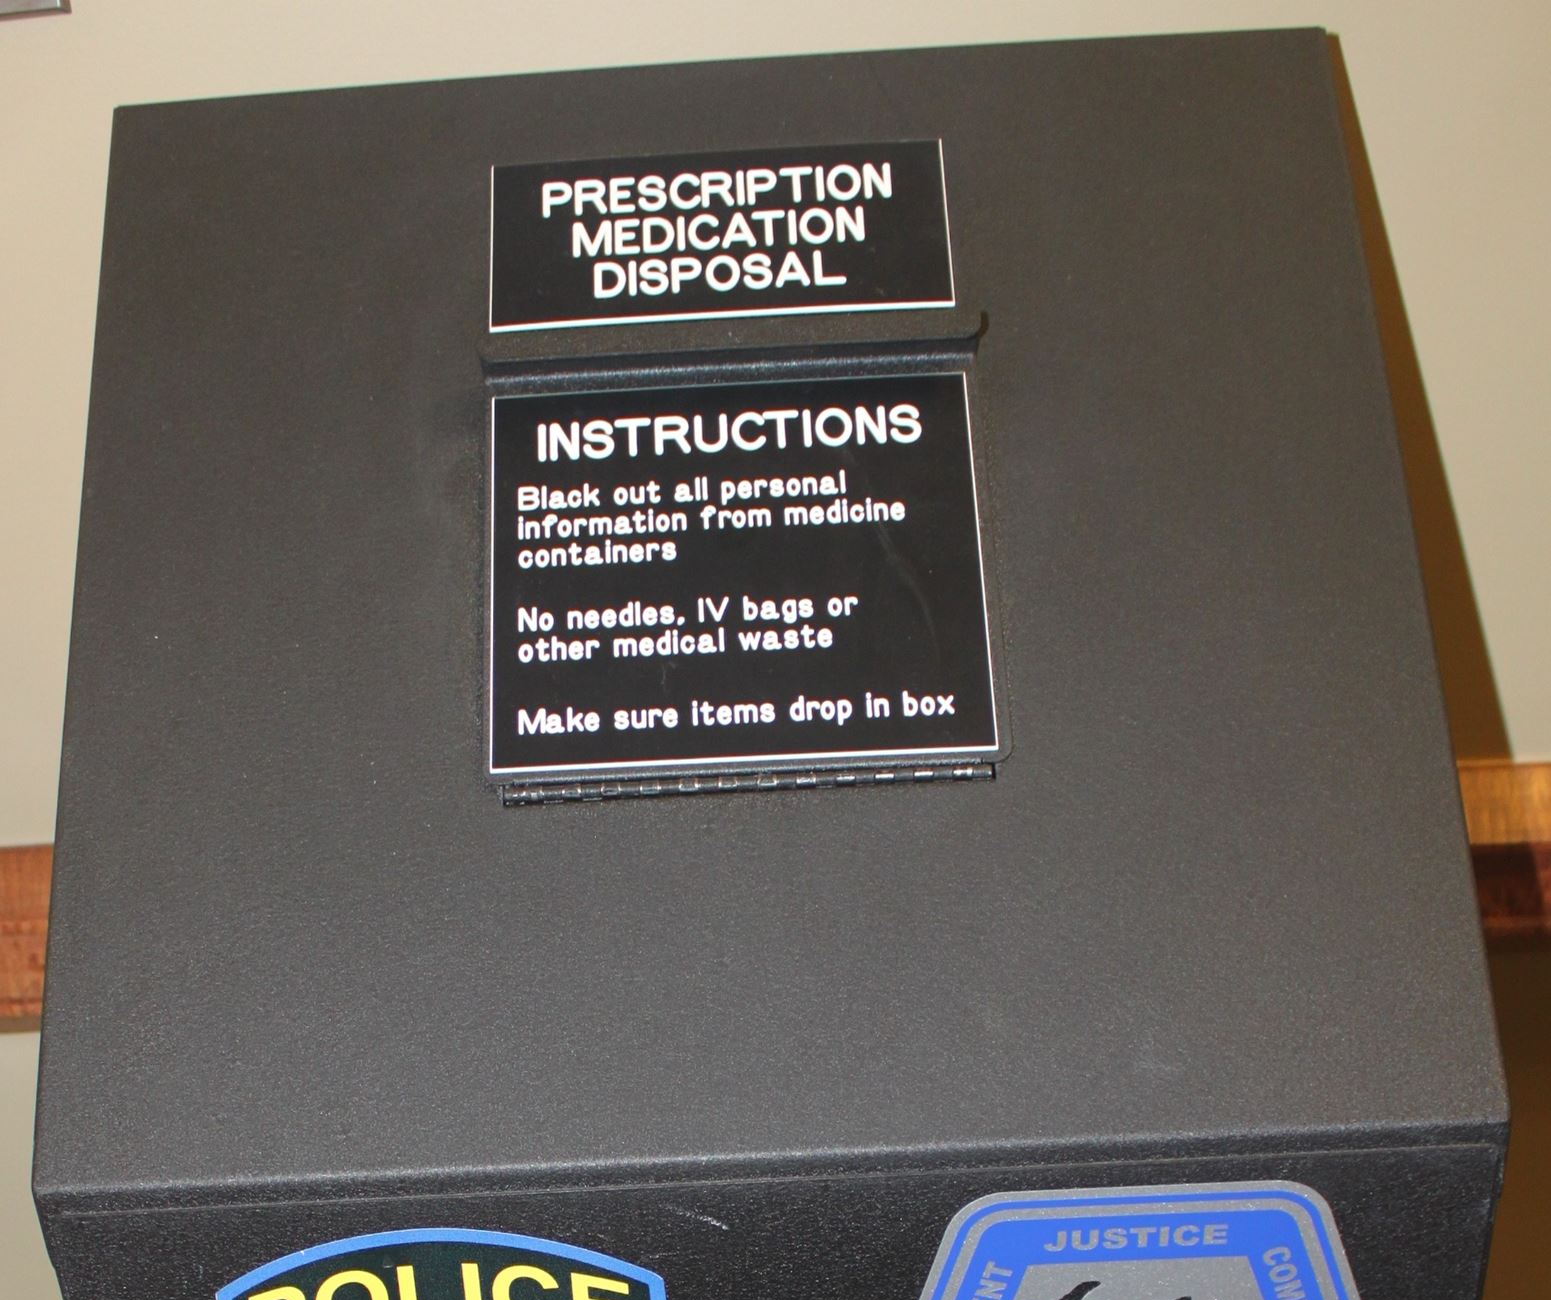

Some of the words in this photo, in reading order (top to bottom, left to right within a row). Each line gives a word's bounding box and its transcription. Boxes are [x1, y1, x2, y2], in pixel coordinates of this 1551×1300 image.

[542, 162, 892, 218] PRESCRIPTION
[571, 205, 865, 258] MEDICATION
[592, 250, 847, 298] DISPOSAL
[537, 404, 922, 462] INSTRUCTIONS
[517, 483, 601, 511] Black
[613, 481, 661, 506] out
[674, 477, 709, 502] all
[721, 470, 846, 504] personal
[517, 508, 687, 540] information
[700, 503, 772, 530] from
[783, 497, 906, 525] medicine
[518, 539, 676, 569] containers
[517, 606, 554, 633] No
[566, 600, 685, 631] needles,
[697, 597, 729, 622] IV
[743, 595, 813, 625] bags
[827, 595, 858, 616] or
[518, 636, 600, 663] other
[613, 630, 725, 658] medical
[738, 626, 833, 651] waste
[517, 707, 600, 735] Make
[613, 705, 678, 731] sure
[691, 700, 775, 726] items
[789, 695, 853, 726] drop
[865, 693, 890, 718] in
[902, 691, 954, 716] box
[1044, 1224, 1228, 1252] JUSTICE
